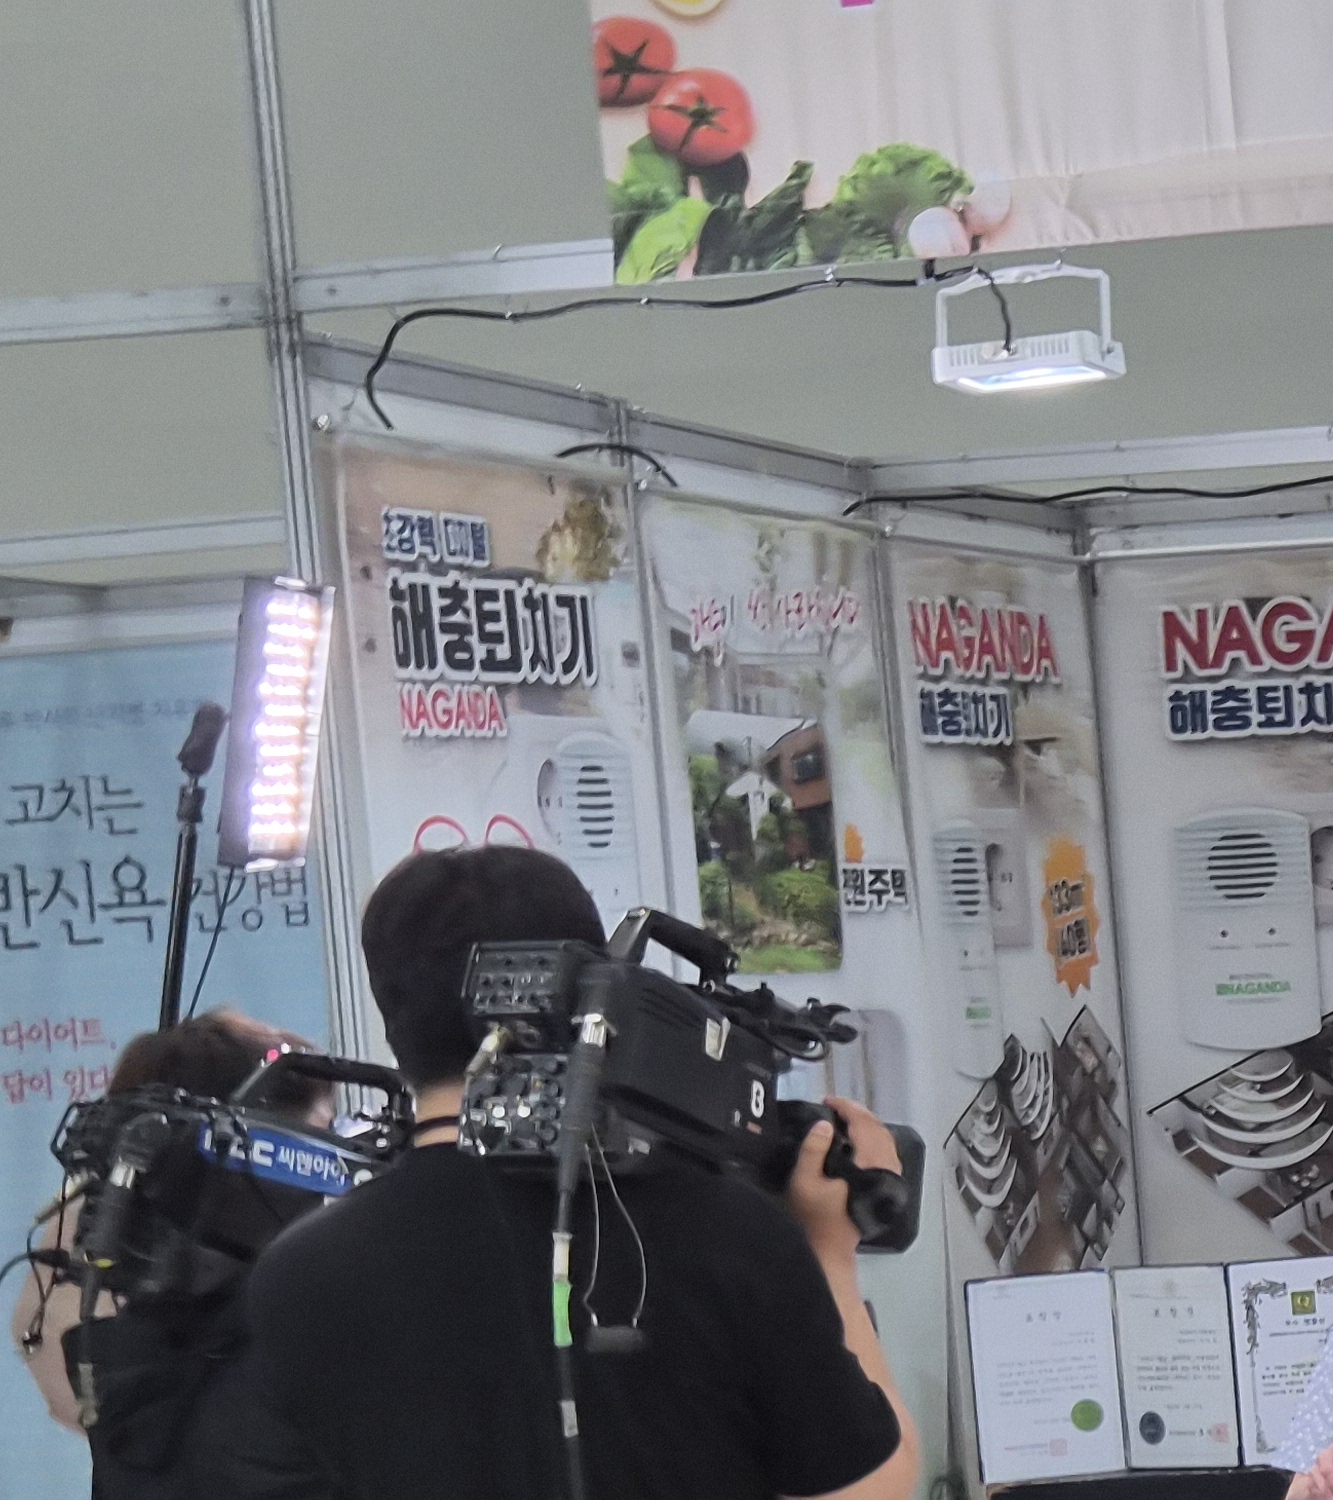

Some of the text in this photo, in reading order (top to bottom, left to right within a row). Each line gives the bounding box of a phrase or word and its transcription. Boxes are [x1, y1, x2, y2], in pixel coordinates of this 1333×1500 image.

[389, 578, 595, 678] 해충퇴치기
[910, 603, 1060, 678] NAGANDA
[6, 775, 143, 835] 고치는
[0, 854, 167, 948] 반신욕
